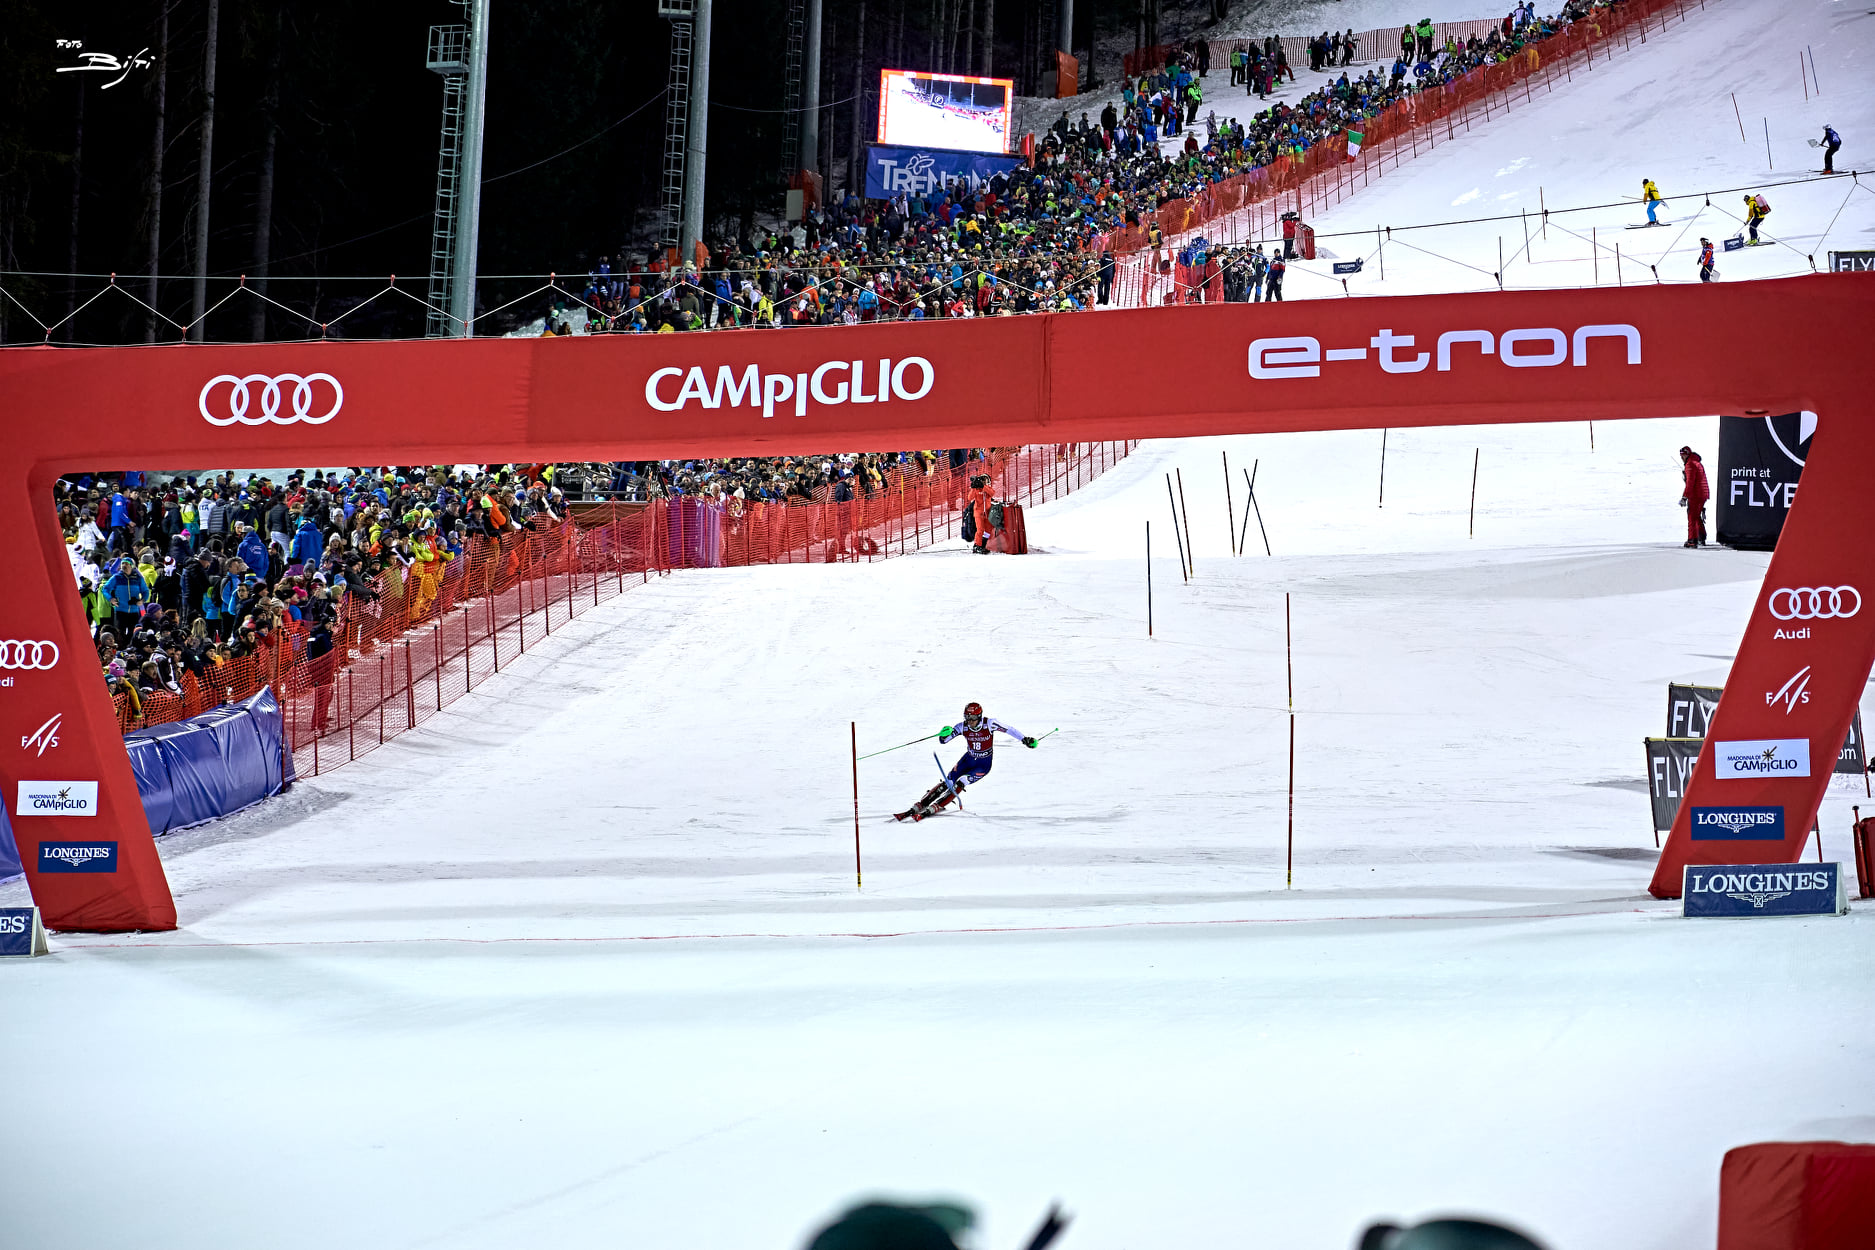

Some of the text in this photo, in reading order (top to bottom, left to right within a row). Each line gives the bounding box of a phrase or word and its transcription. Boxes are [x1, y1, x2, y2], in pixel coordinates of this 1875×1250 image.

[1248, 323, 1642, 380] e-tron
[645, 356, 935, 418] CAMPIGLIO
[1731, 466, 1771, 479] print at
[1773, 627, 1811, 640] Audi
[0, 676, 14, 687] di
[972, 741, 982, 751] 18
[1734, 759, 1798, 773] CAMPIGLIO
[33, 799, 87, 811] CAMPIGLIO
[1697, 812, 1776, 825] LONGINES
[44, 847, 110, 859] LONGINES
[1692, 871, 1830, 893] LONGINES
